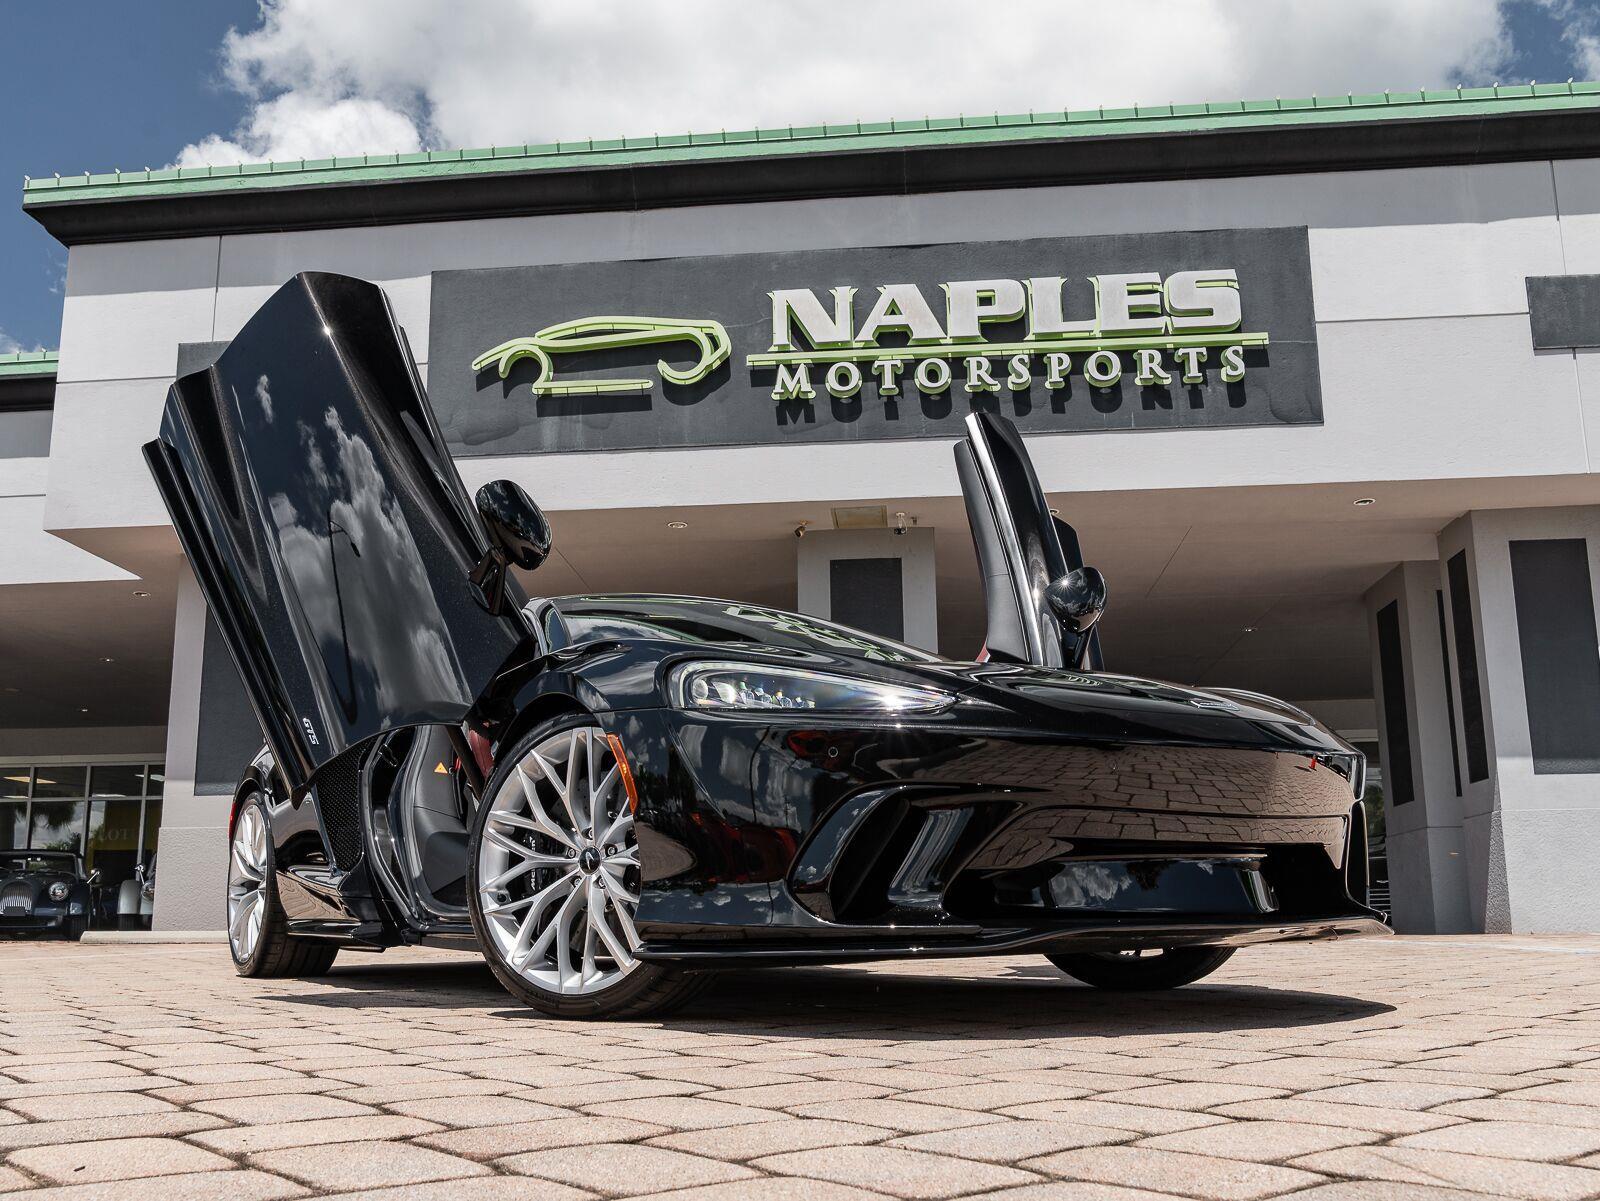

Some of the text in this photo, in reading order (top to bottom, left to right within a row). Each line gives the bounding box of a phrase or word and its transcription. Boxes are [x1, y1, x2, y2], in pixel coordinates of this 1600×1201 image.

[768, 268, 1242, 352] NAPLES
[772, 346, 1246, 399] MOTORSPORTS
[303, 718, 319, 745] GTS
